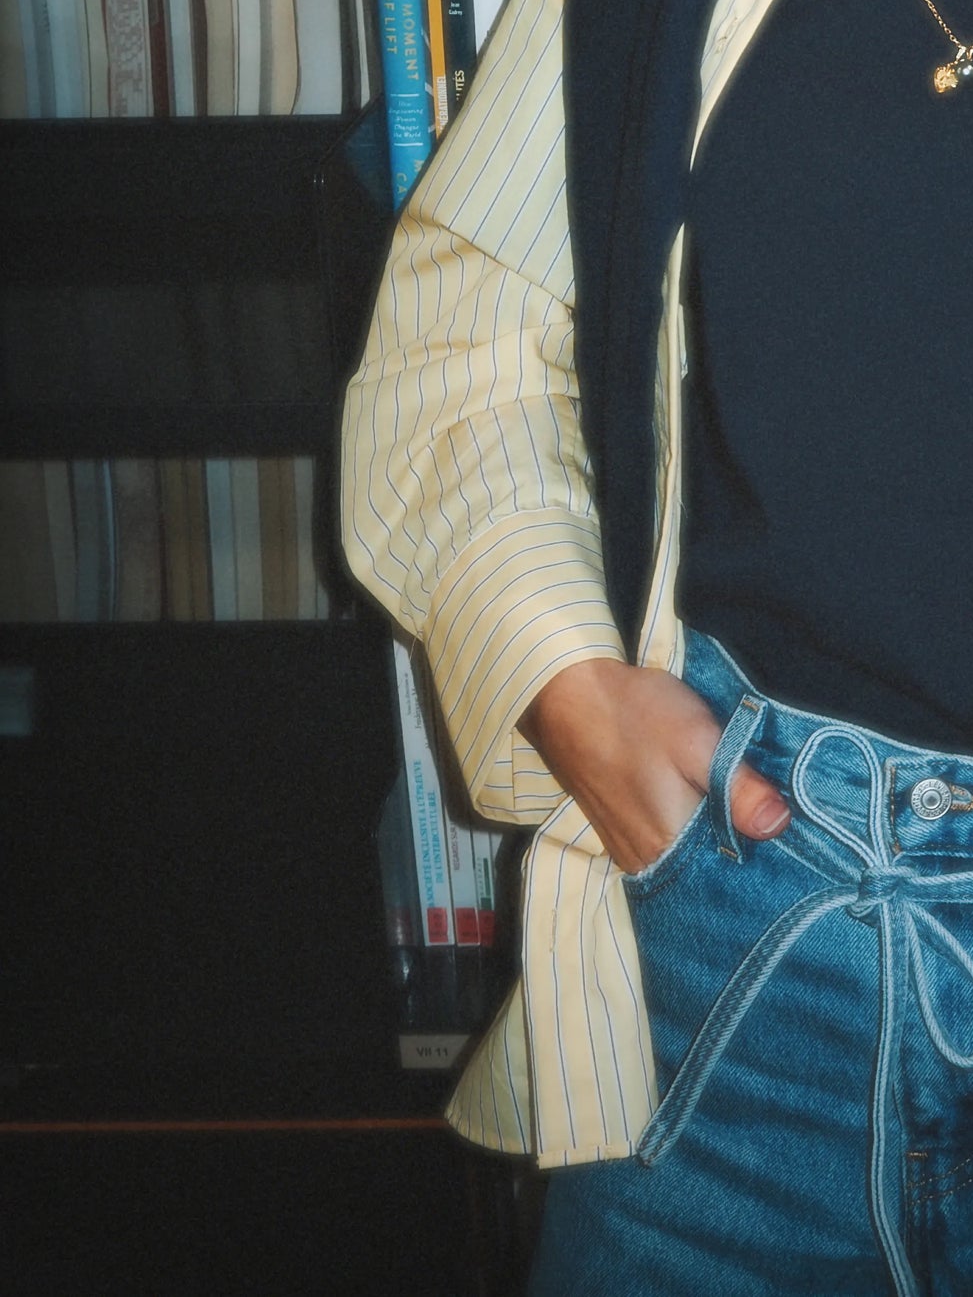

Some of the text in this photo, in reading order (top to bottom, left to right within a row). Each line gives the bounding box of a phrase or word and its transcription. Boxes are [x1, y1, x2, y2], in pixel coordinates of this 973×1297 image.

[385, 17, 398, 54] LIFT
[401, 1, 420, 81] MOMENT
[416, 816, 430, 863] INCLUSIVE
[416, 1047, 449, 1057] VII 11
